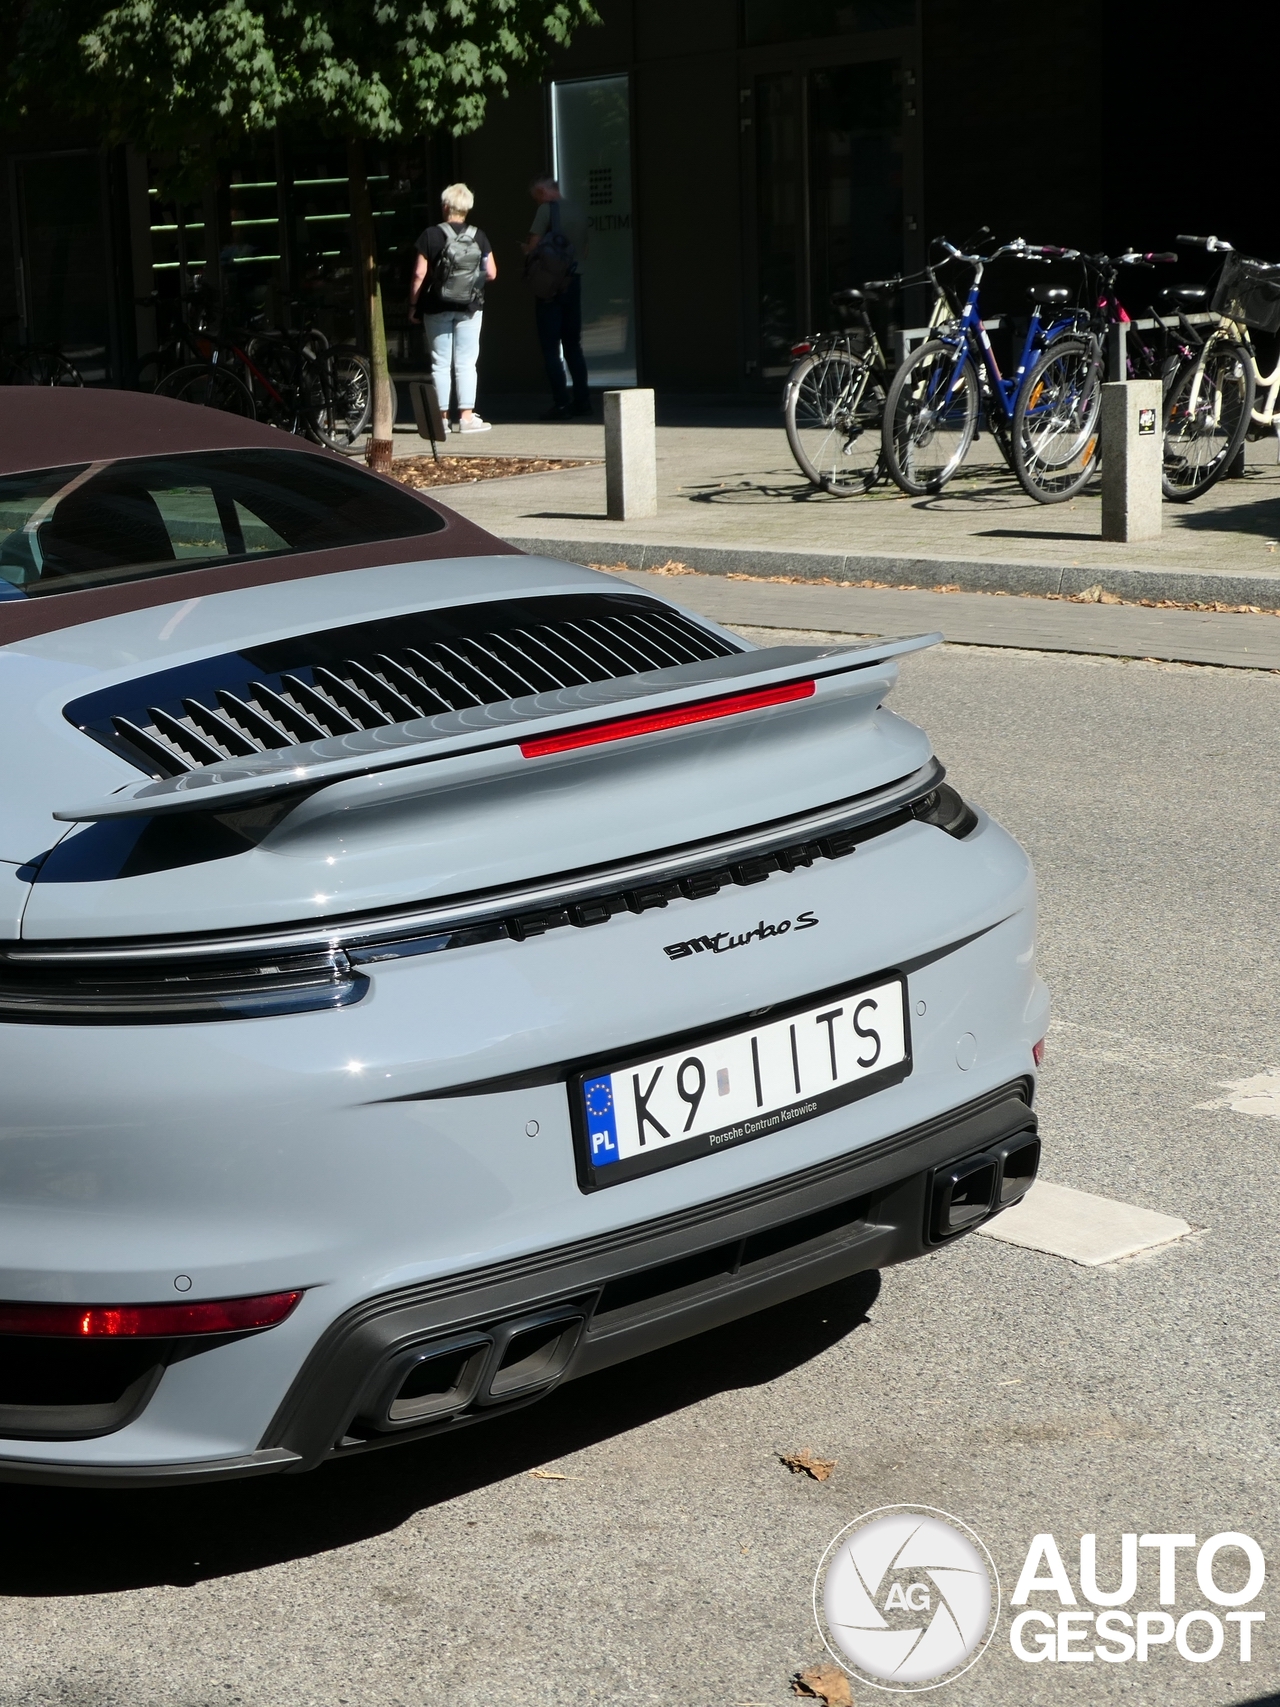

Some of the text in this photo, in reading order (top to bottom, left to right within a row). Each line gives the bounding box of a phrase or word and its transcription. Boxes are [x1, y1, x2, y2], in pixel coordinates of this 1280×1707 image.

[506, 836, 857, 942] PORSCHE
[793, 910, 819, 932] S
[631, 1056, 706, 1147] K9
[592, 1130, 615, 1154] PL
[709, 1102, 818, 1146] Porsche Centrum Katowice
